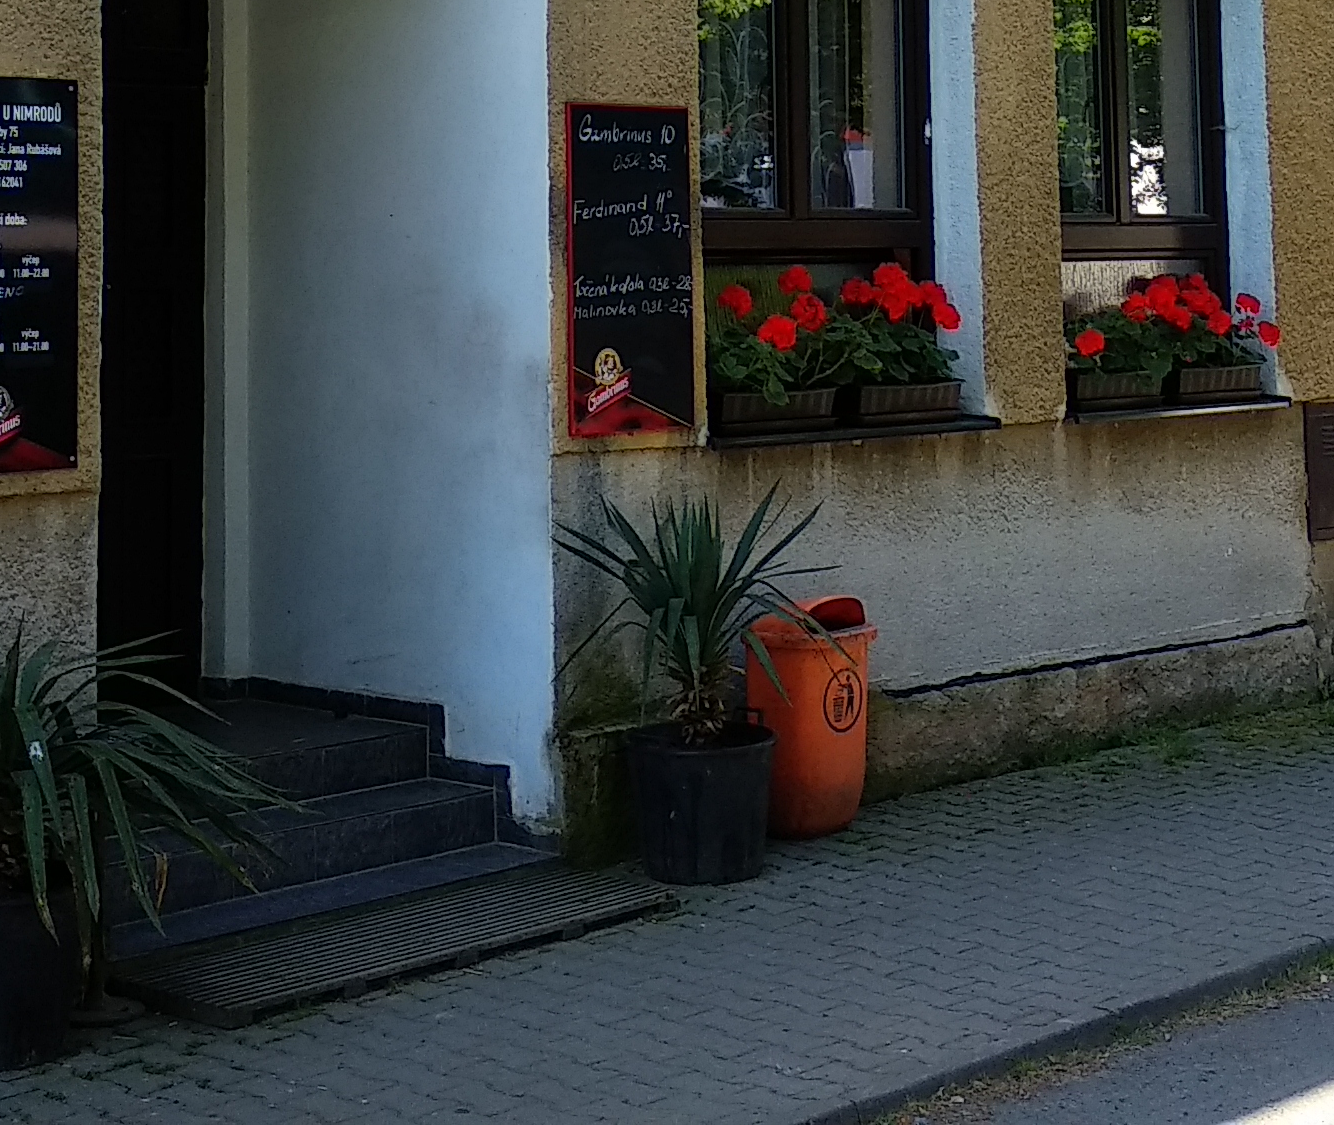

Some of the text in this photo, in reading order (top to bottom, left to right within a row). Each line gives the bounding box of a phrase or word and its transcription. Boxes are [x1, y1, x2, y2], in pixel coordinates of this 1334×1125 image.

[2, 104, 11, 121] U
[13, 102, 62, 122] NIMRODŮ
[9, 125, 19, 137] 75
[578, 113, 676, 145] Gambrinus 10
[573, 194, 648, 224] Ferdinand
[587, 376, 630, 413] Gambrinus
